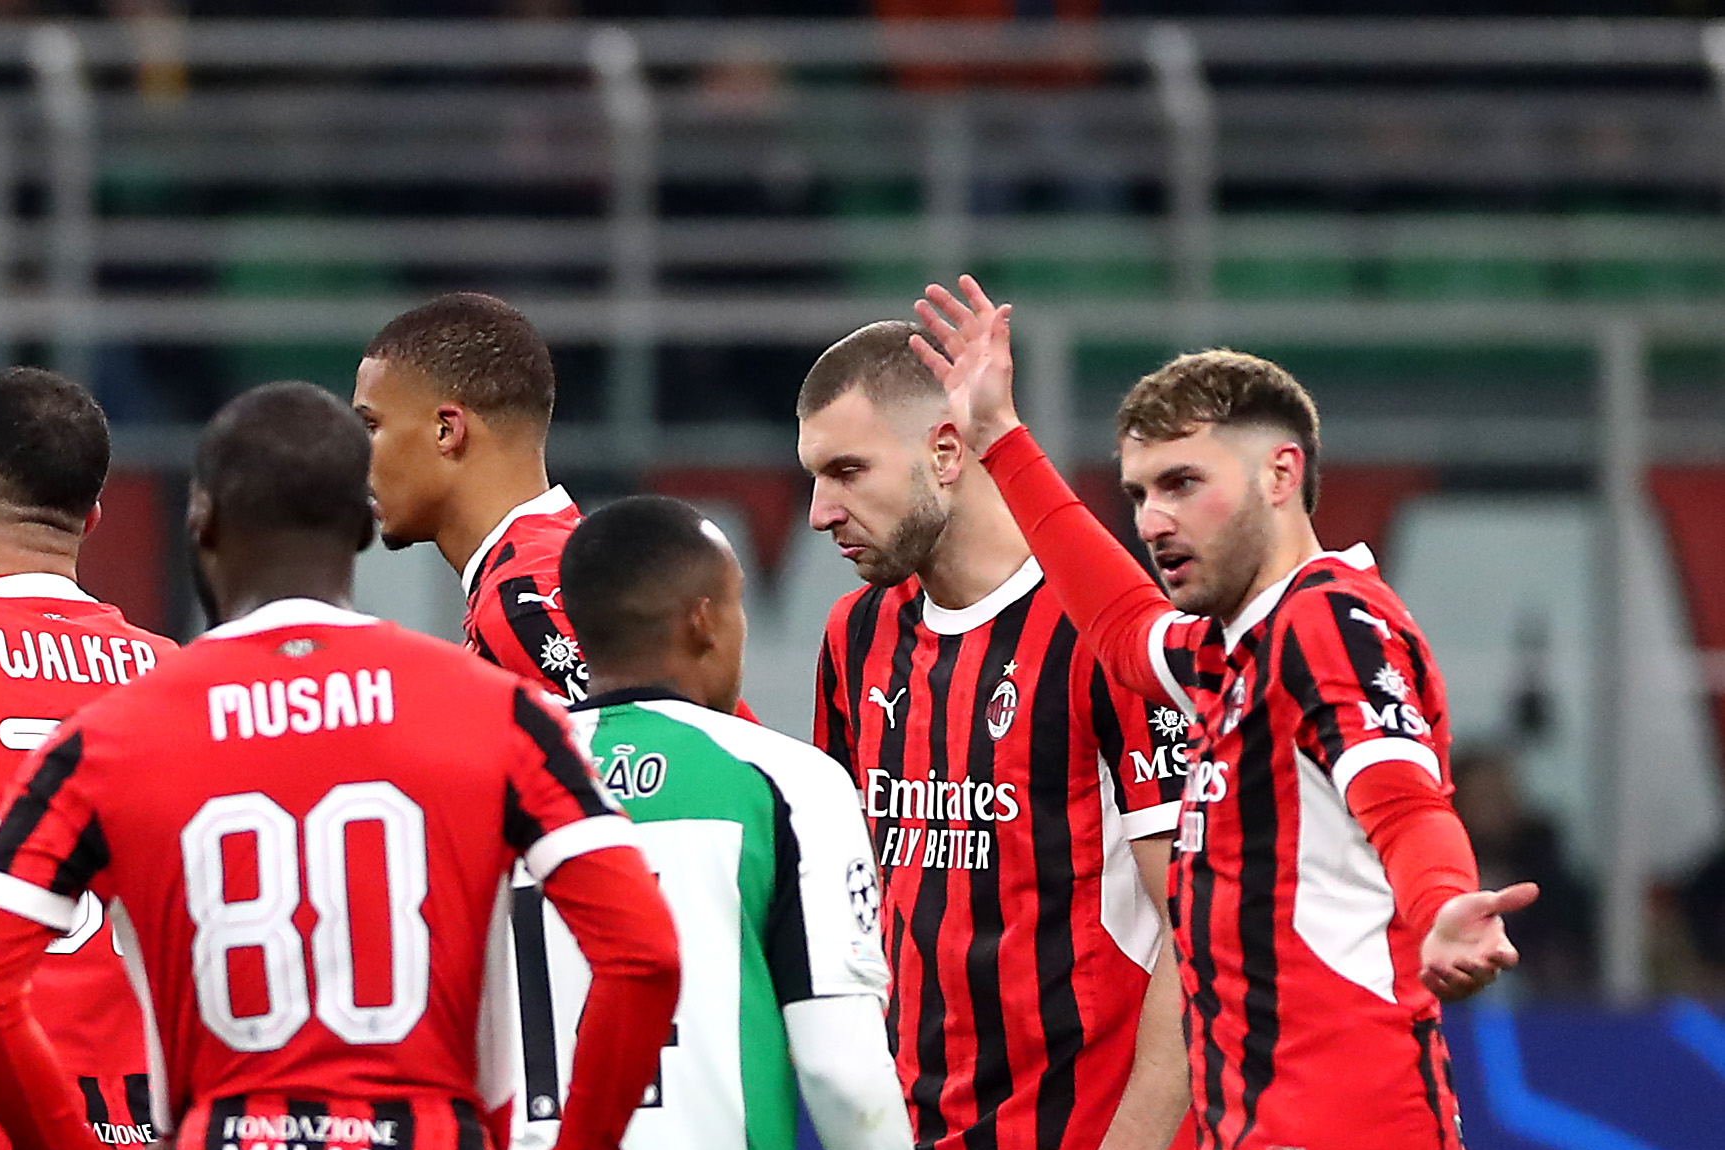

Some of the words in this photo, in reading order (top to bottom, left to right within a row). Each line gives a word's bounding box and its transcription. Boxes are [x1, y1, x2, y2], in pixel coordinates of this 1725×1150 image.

[208, 668, 395, 741] MUSAH
[593, 744, 667, 799] ÃO
[1129, 743, 1188, 783] MS
[867, 768, 1019, 821] Emirates
[881, 827, 922, 867] FLY
[922, 829, 991, 869] BETTER
[181, 780, 429, 1052] 80
[90, 1122, 158, 1145] AZIONE
[223, 1115, 398, 1145] FONDAZIONE
